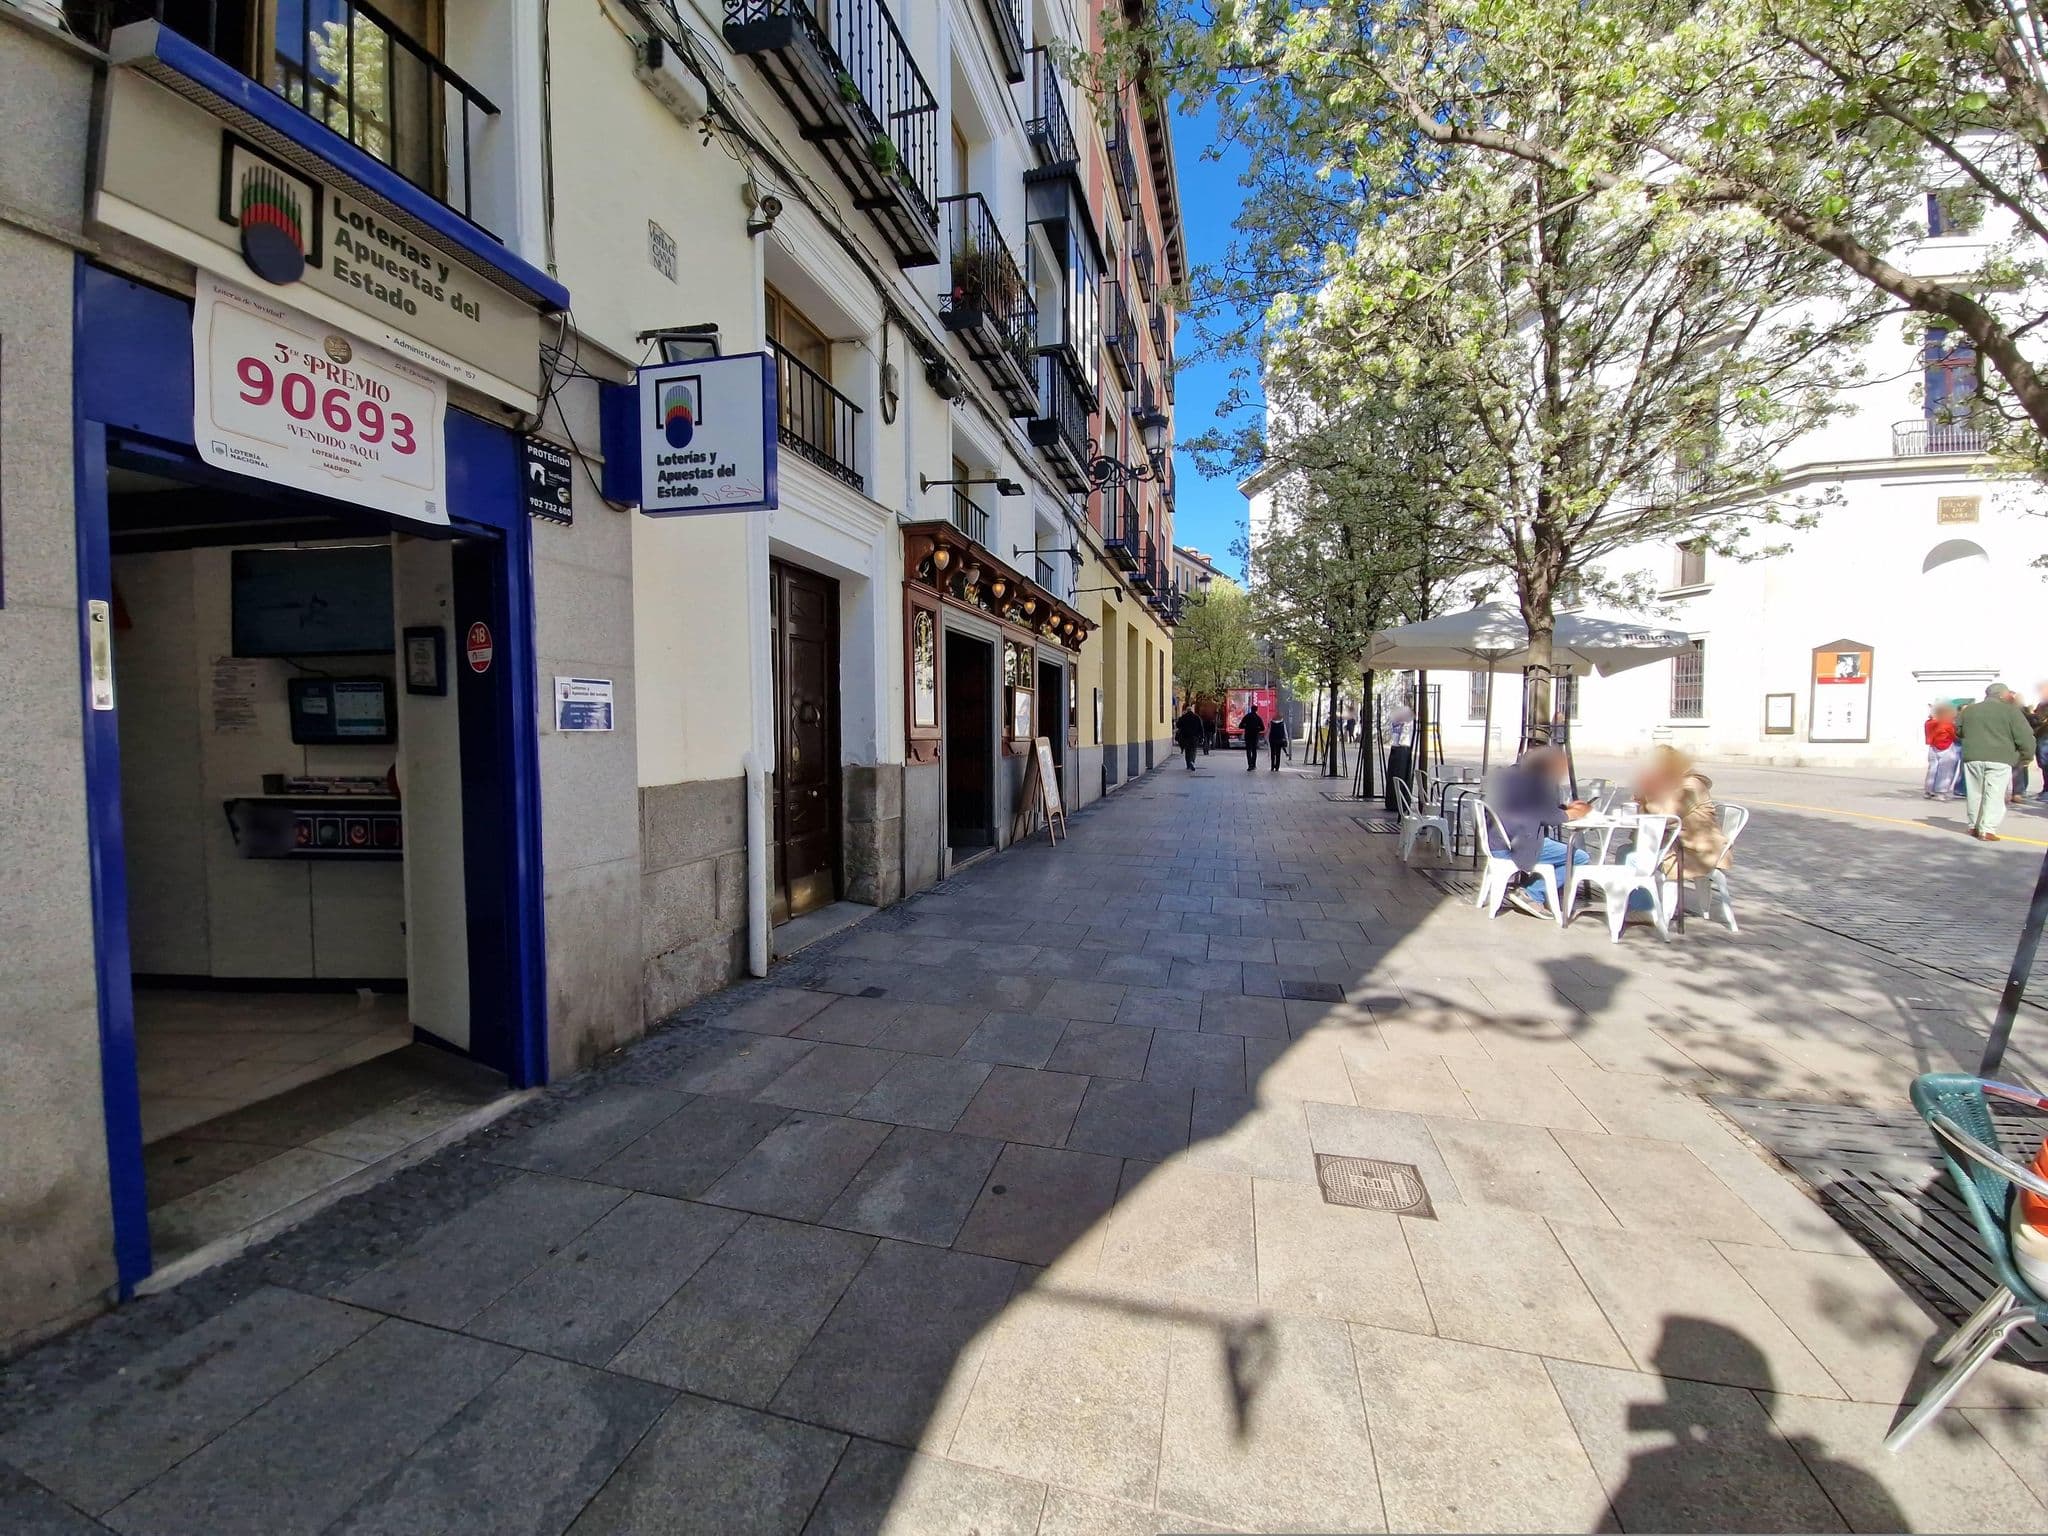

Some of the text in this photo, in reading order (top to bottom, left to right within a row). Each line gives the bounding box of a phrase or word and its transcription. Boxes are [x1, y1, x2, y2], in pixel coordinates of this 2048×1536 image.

[333, 195, 449, 285] Loterías y
[333, 255, 418, 317] Estado
[334, 226, 481, 323] Apuestas del
[393, 337, 451, 369] Administración
[303, 352, 391, 403] PREMIO
[236, 356, 418, 455] 90693
[287, 423, 347, 450] VENDIDO
[230, 453, 270, 469] NACIONAL
[323, 462, 350, 474] MADRID
[527, 445, 570, 467] PROTEGIDO
[656, 451, 717, 466] Loterías y
[658, 463, 736, 485] Apuestas del
[657, 483, 699, 498] Estado
[544, 501, 558, 513] 732
